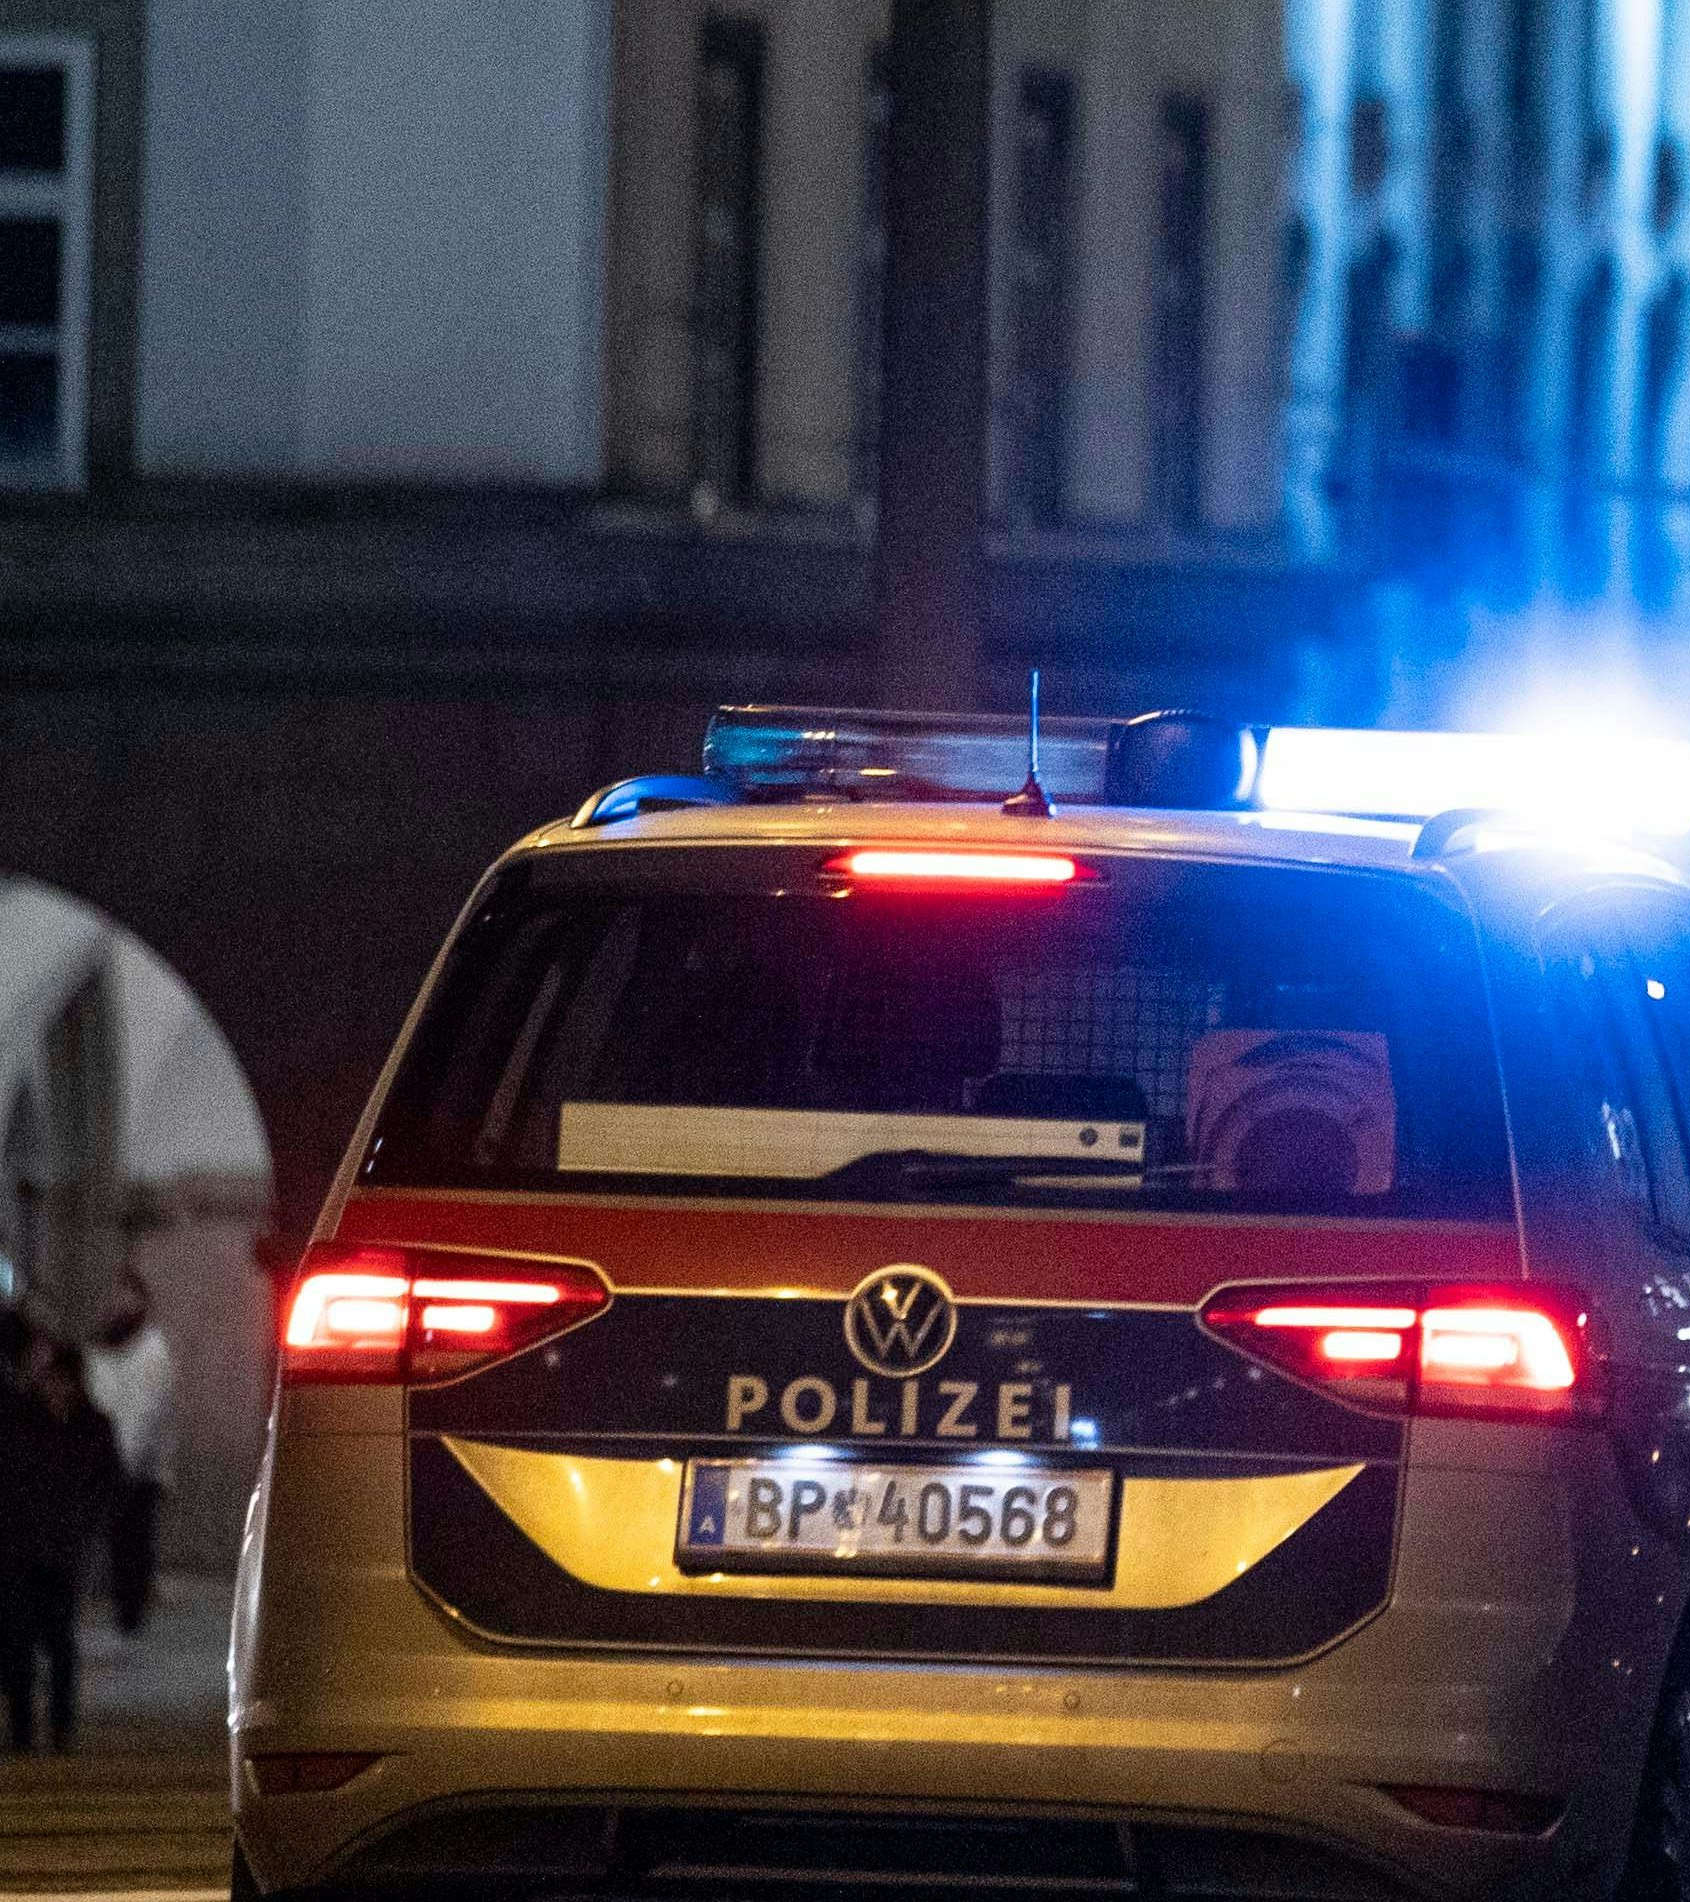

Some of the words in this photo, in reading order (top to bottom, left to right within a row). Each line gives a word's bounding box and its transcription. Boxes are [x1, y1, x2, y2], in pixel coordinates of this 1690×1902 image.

[727, 1375, 1071, 1440] POLIZEI
[700, 1514, 716, 1534] A
[746, 1477, 827, 1541] BP
[877, 1479, 1078, 1546] 40568
